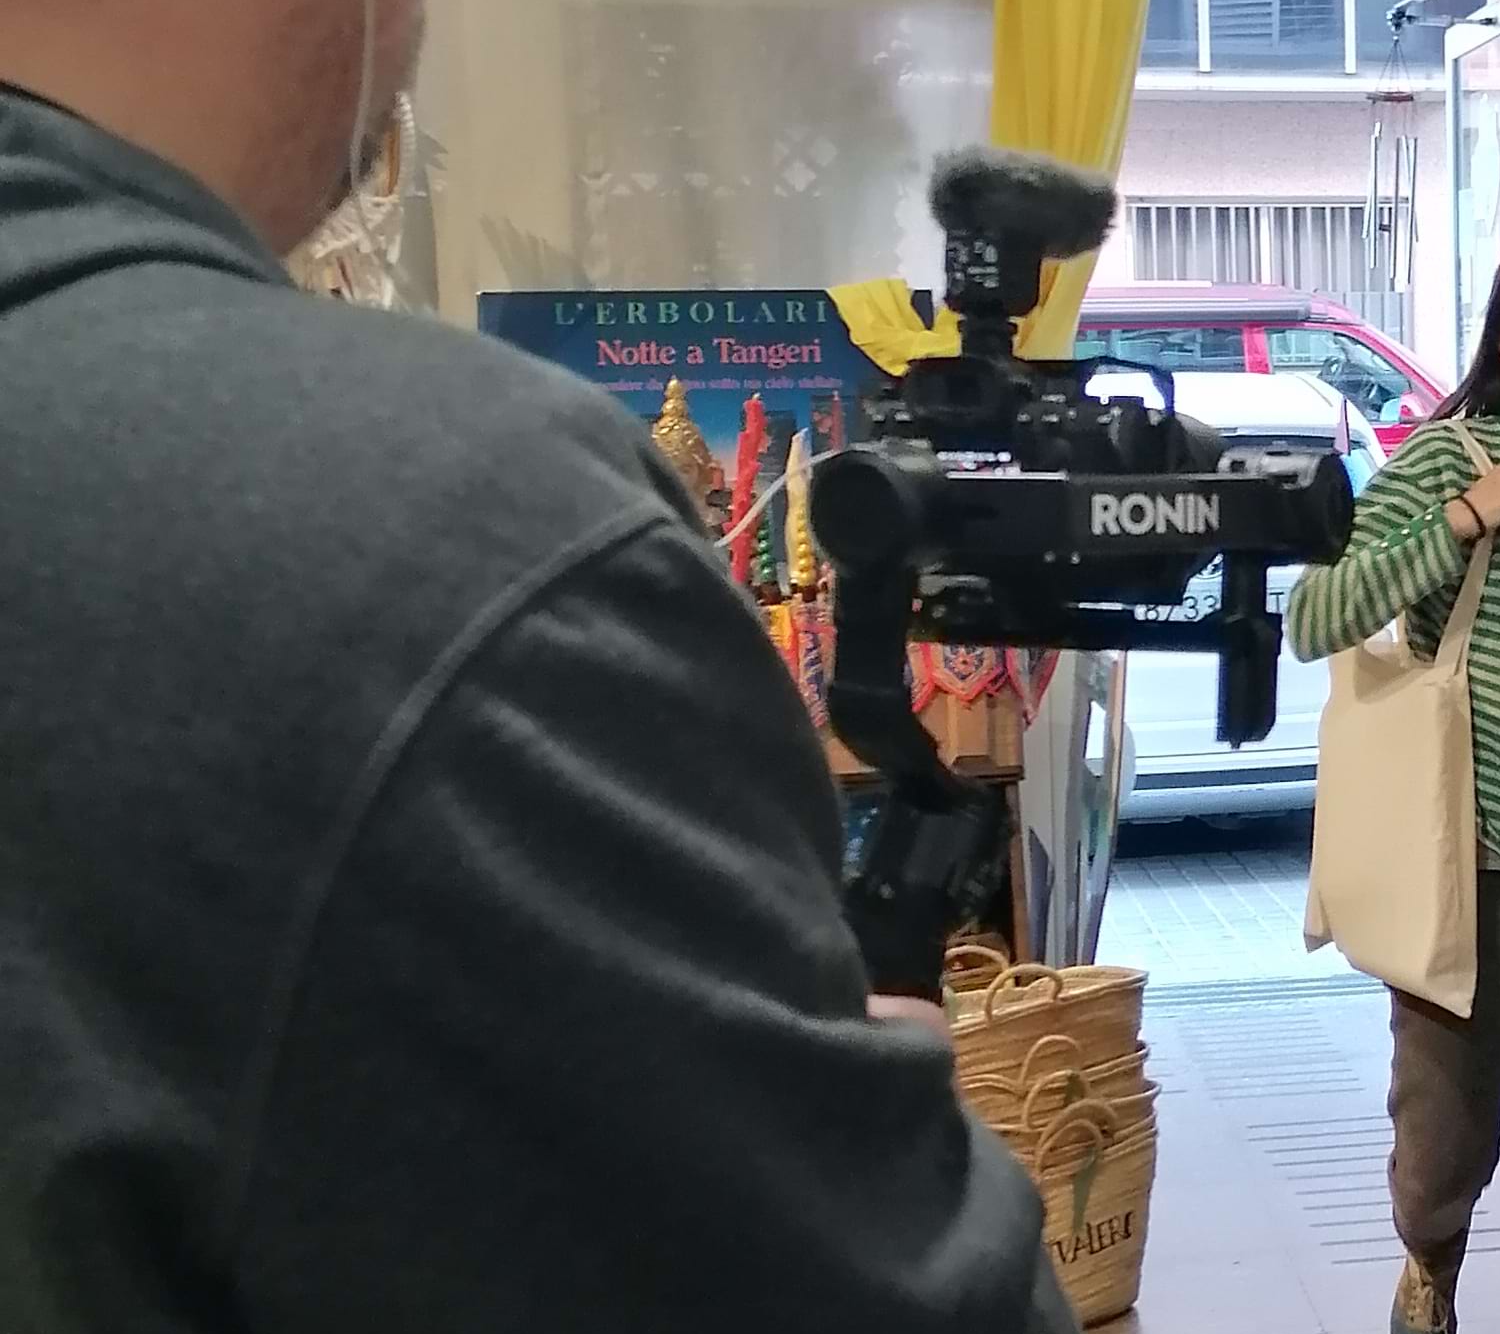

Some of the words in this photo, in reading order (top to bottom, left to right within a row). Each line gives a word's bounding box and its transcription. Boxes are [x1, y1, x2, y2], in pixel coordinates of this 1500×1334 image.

[554, 300, 828, 326] L'ERBOLARI
[597, 340, 677, 366] Notte
[687, 346, 704, 364] a
[712, 338, 823, 369] Tangeri
[1090, 493, 1220, 536] RONIN
